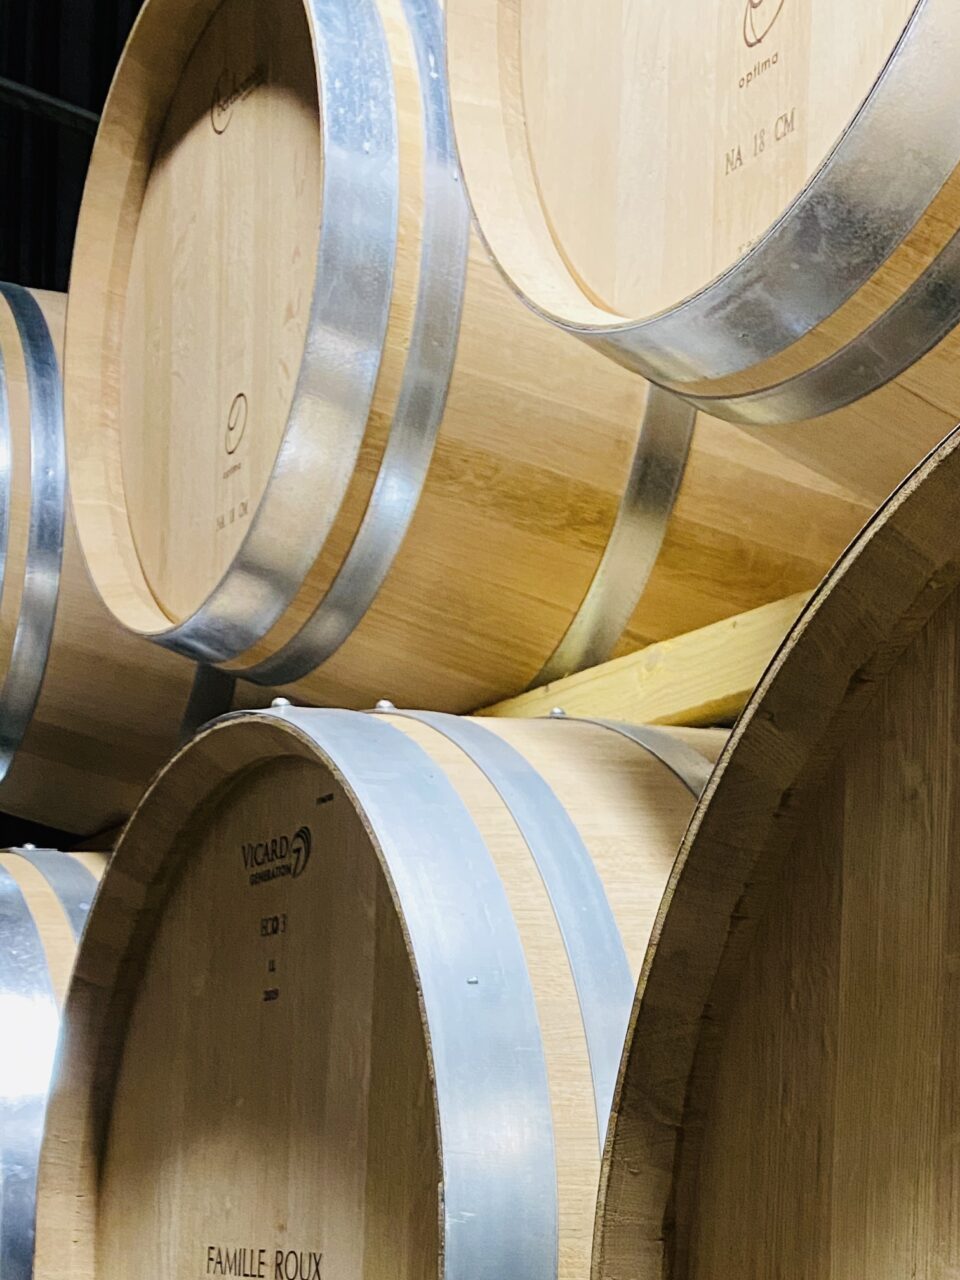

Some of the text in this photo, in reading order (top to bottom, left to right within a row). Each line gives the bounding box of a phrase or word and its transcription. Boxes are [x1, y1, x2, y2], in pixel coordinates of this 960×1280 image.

[739, 52, 779, 88] optima
[725, 146, 743, 175] NA
[774, 107, 796, 141] CM
[241, 836, 289, 869] VICARD
[206, 1246, 266, 1278] FAMILLE
